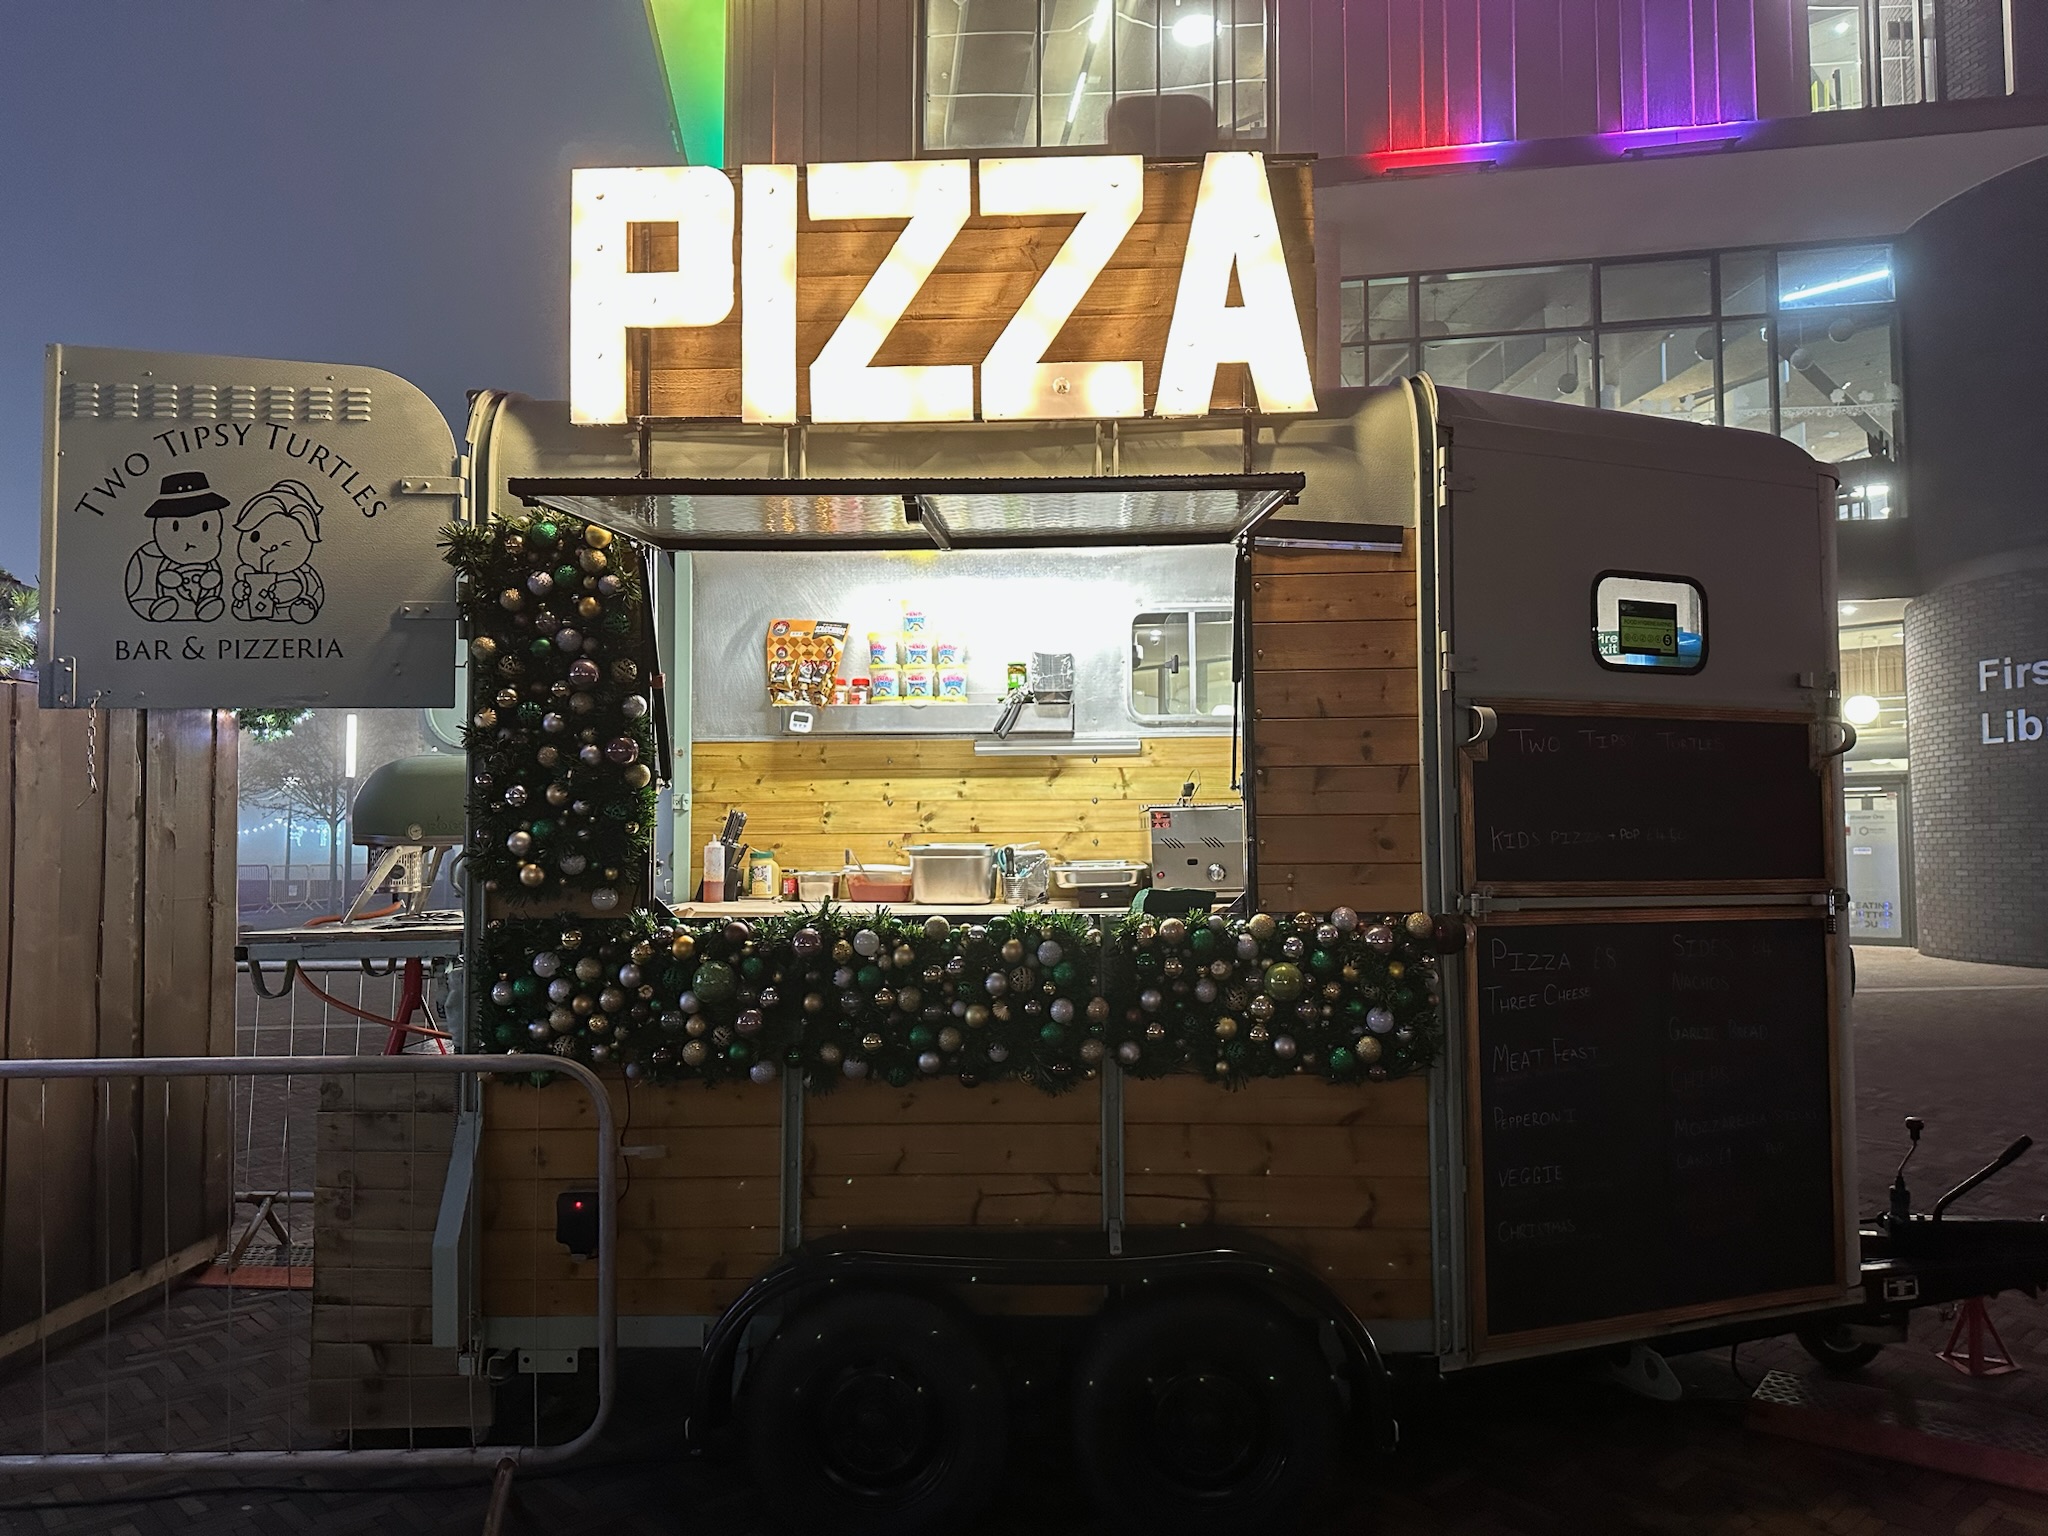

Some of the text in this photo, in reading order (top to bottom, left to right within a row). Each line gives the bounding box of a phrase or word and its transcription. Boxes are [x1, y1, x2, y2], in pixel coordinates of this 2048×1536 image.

[570, 151, 1319, 425] PIZZA
[74, 422, 387, 518] TWO TIPSY TURTLES
[115, 636, 345, 660] BAR & PIZZERIA
[1979, 656, 2048, 692] Firs
[1982, 708, 2048, 744] Lib
[1508, 728, 1725, 753] TWO TIPSY TURTLES
[1491, 826, 1541, 851] KIDS
[1619, 828, 1640, 840] POP
[1491, 937, 1571, 972] PIZZA
[1672, 933, 1734, 960] SIDES
[1672, 971, 1730, 991] NACHOS
[1483, 983, 1592, 1015] THREE CHEESE
[1668, 1016, 1768, 1041] GARLIC BREAD
[1493, 1038, 1598, 1073] MEAT FEAST
[1493, 1106, 1577, 1131] PEPPERONI
[1499, 1164, 1562, 1187] VEGGIE
[1498, 1219, 1576, 1243] CHRISTMAS
